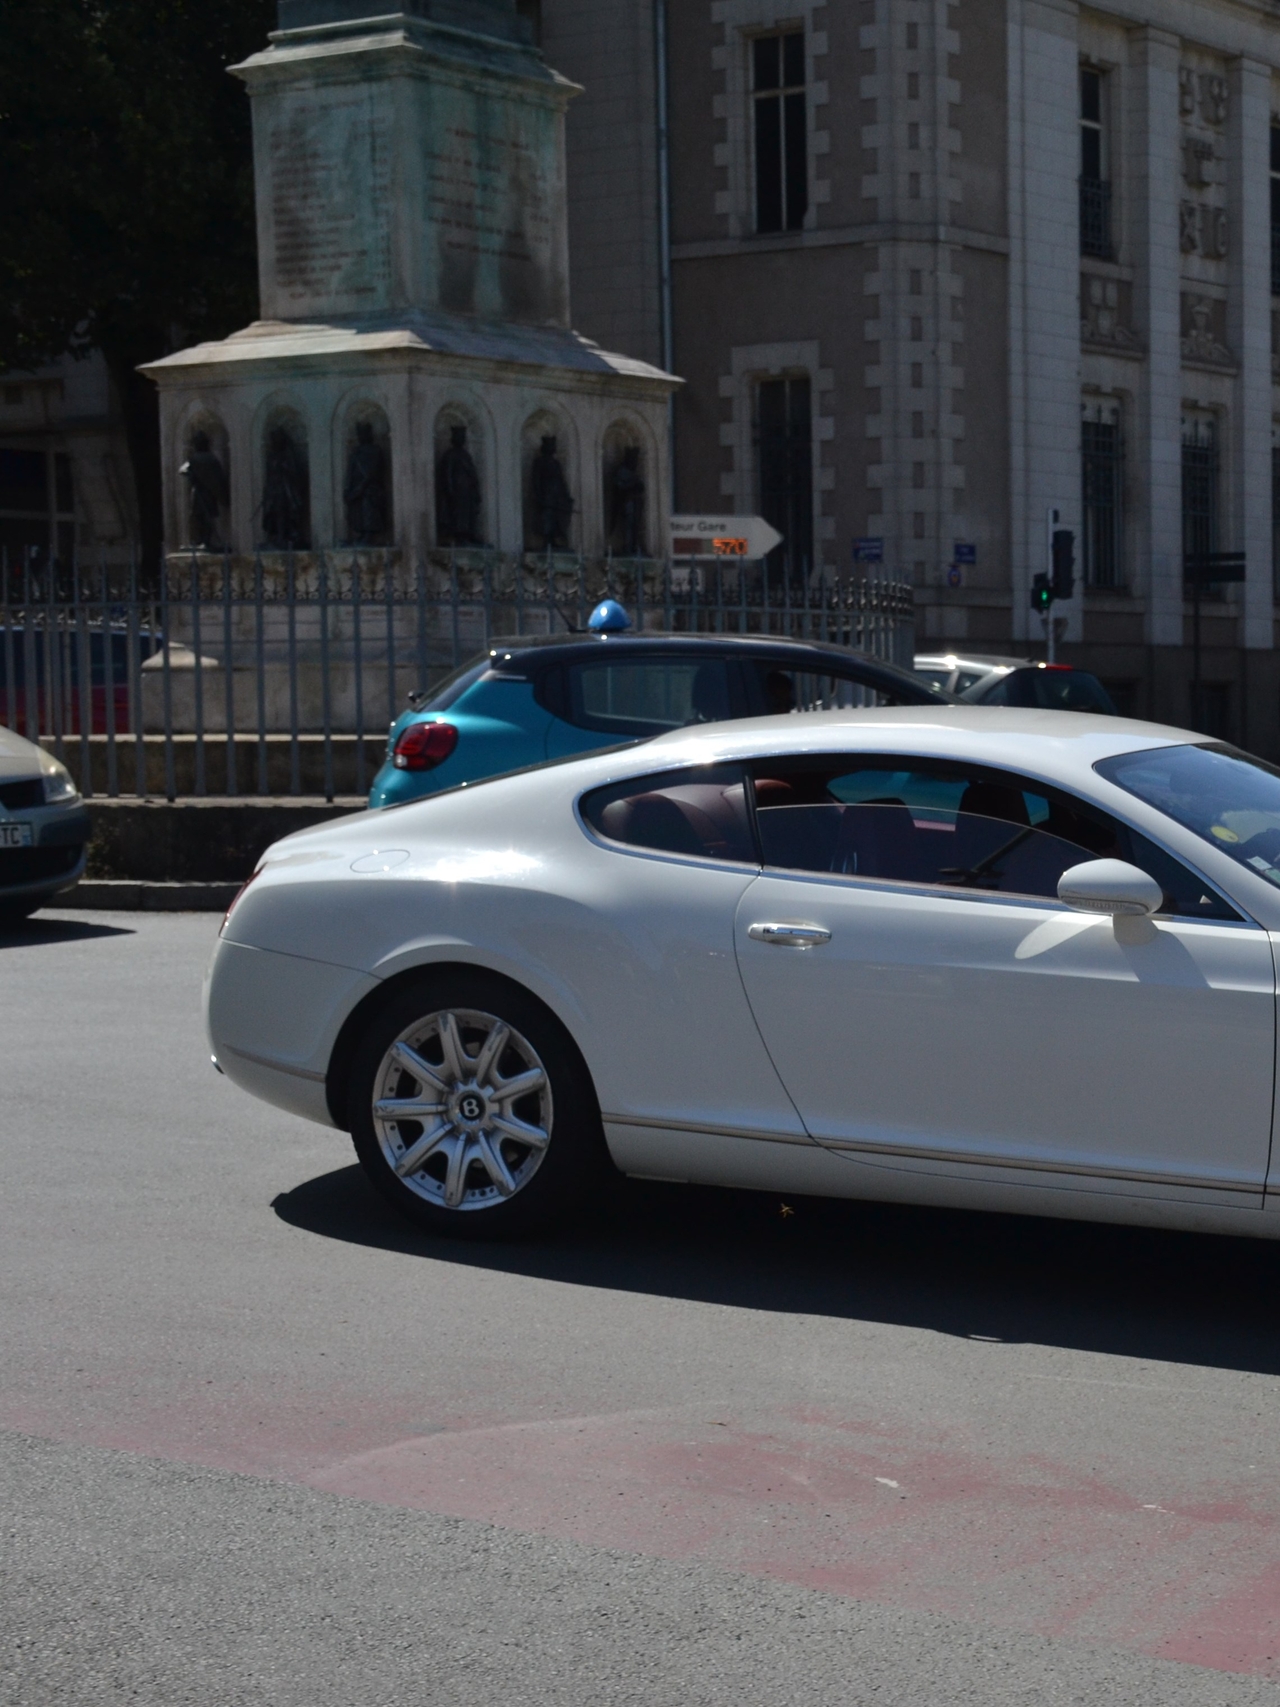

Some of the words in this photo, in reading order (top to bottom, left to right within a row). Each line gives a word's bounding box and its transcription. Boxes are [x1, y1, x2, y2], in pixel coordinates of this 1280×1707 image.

[697, 520, 726, 532] Gare
[711, 537, 748, 555] 570
[462, 1098, 479, 1117] B
